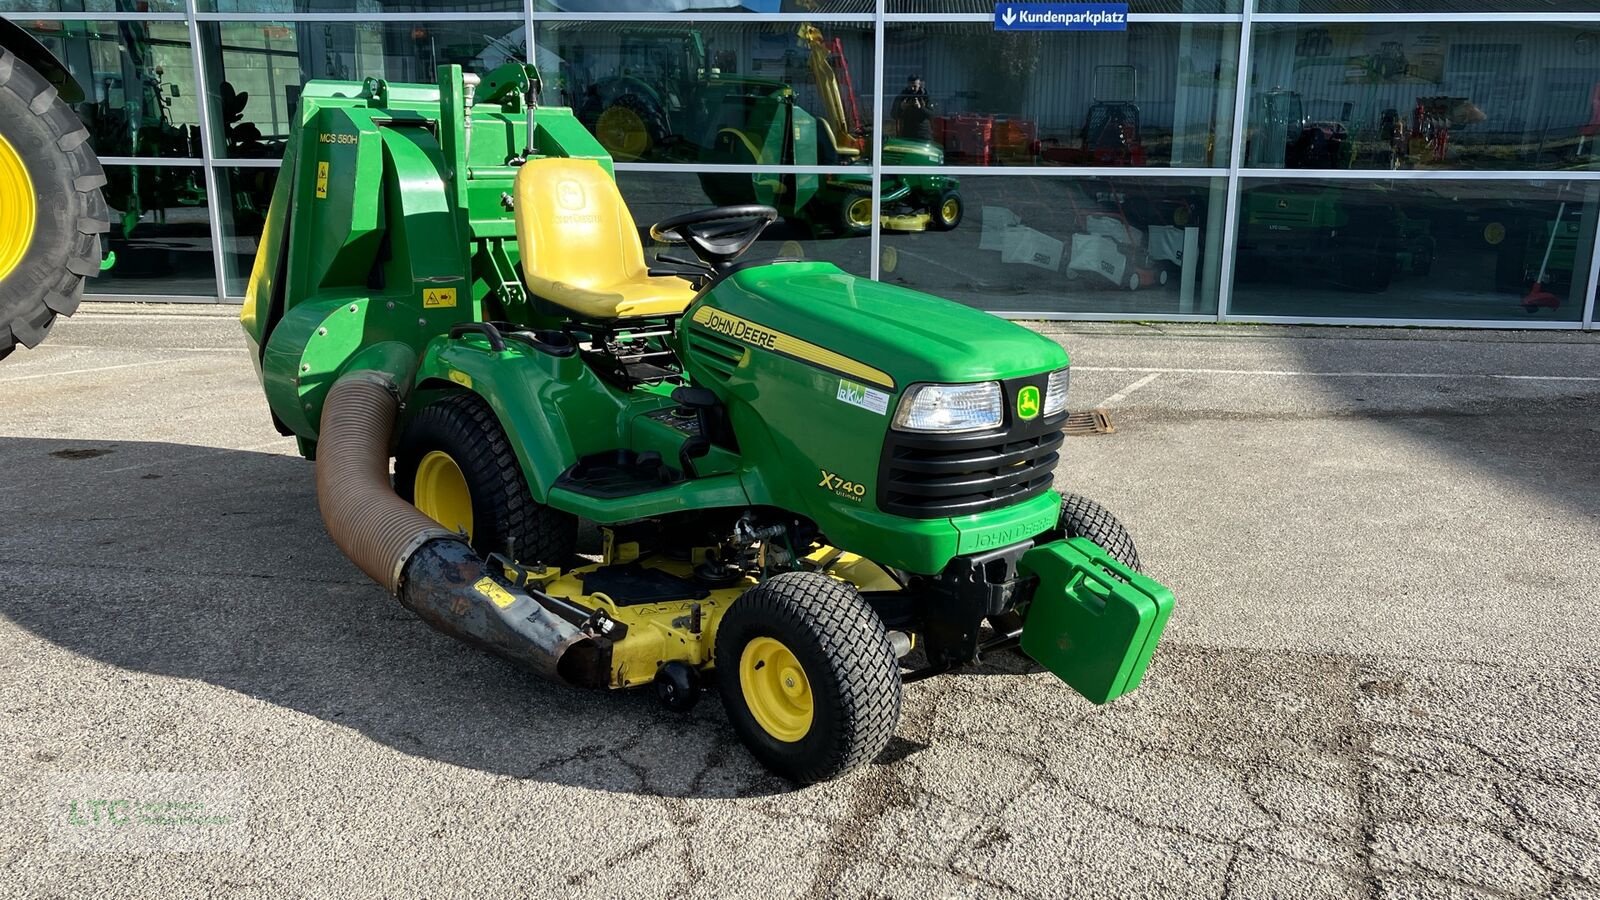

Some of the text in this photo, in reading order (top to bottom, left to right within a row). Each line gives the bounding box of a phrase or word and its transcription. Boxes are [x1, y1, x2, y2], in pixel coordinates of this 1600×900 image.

[1019, 10, 1125, 26] Kundenparkplatz
[320, 133, 358, 144] MCS 580H
[704, 311, 777, 348] JOHN DEERE
[839, 388, 864, 405] RKM
[818, 470, 866, 496] X740
[967, 528, 1013, 549] JOHN
